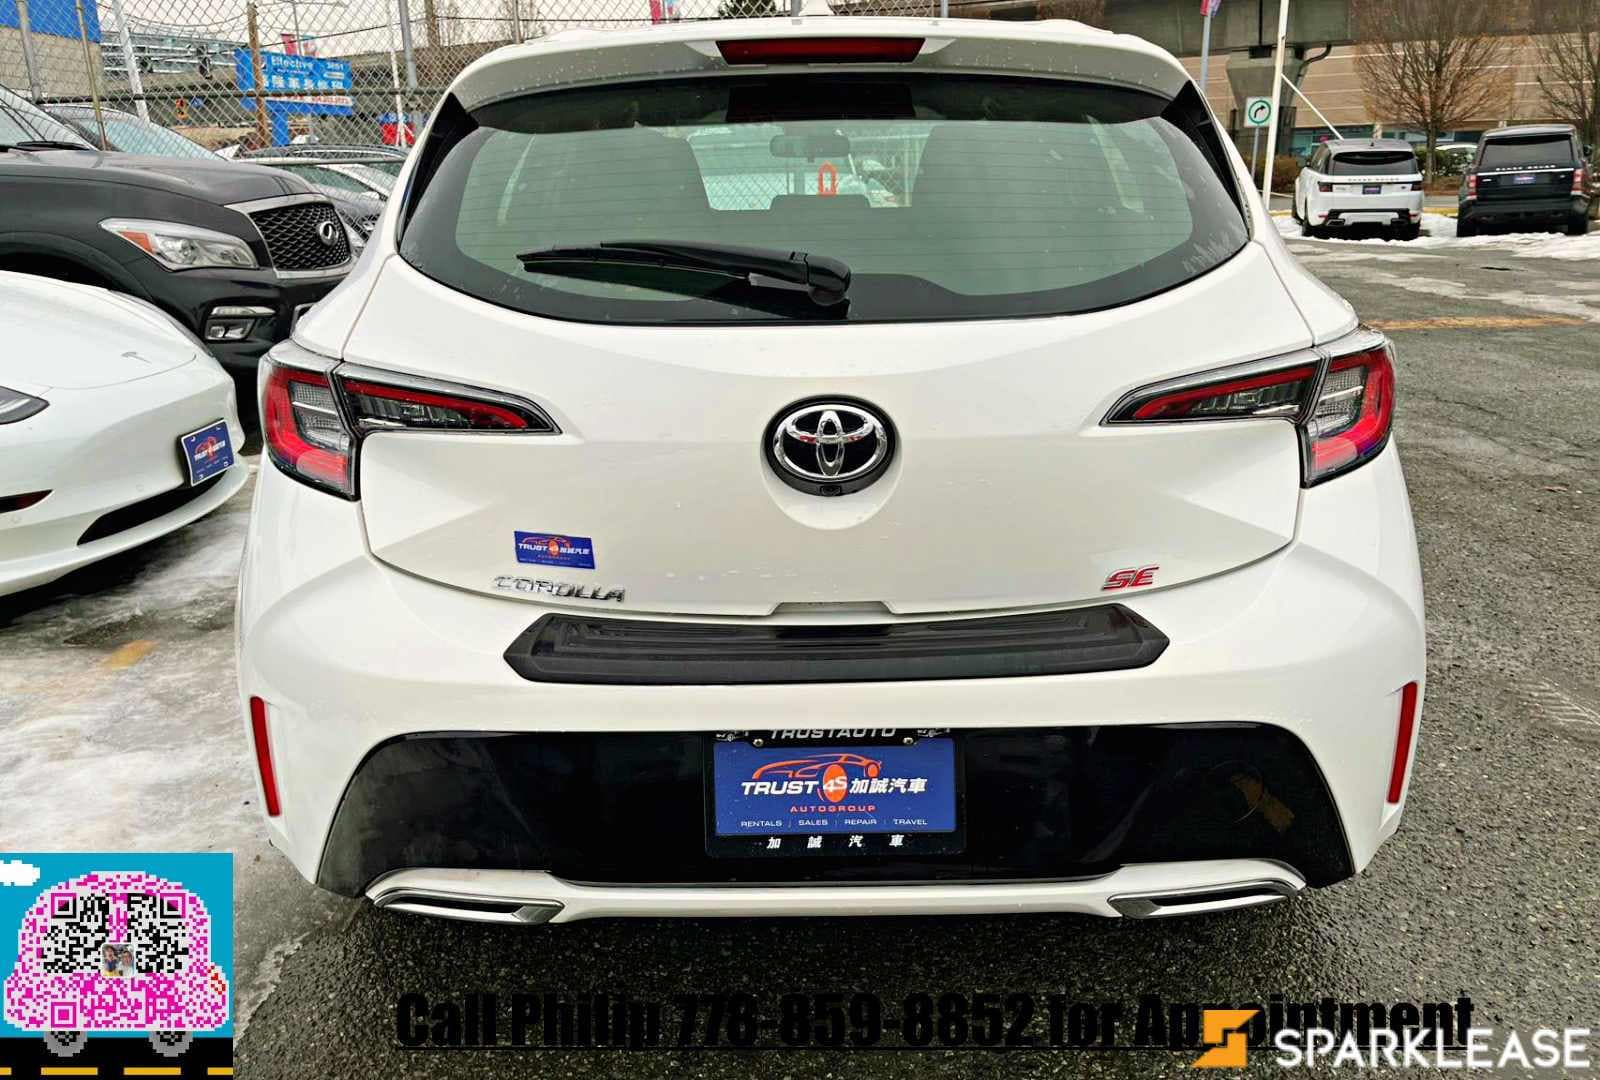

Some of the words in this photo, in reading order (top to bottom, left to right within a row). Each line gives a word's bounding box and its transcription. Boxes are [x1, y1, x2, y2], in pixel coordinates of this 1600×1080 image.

[1101, 564, 1160, 590] SE
[494, 576, 626, 602] COROLLA
[741, 780, 819, 795] TRUST
[822, 776, 848, 793] 4S
[850, 777, 928, 794] 加誠汽車
[790, 804, 877, 813] AUTOGROUP
[741, 820, 782, 828] RENTALS
[844, 818, 877, 826] REPAIR
[893, 818, 928, 826] TRAVEL
